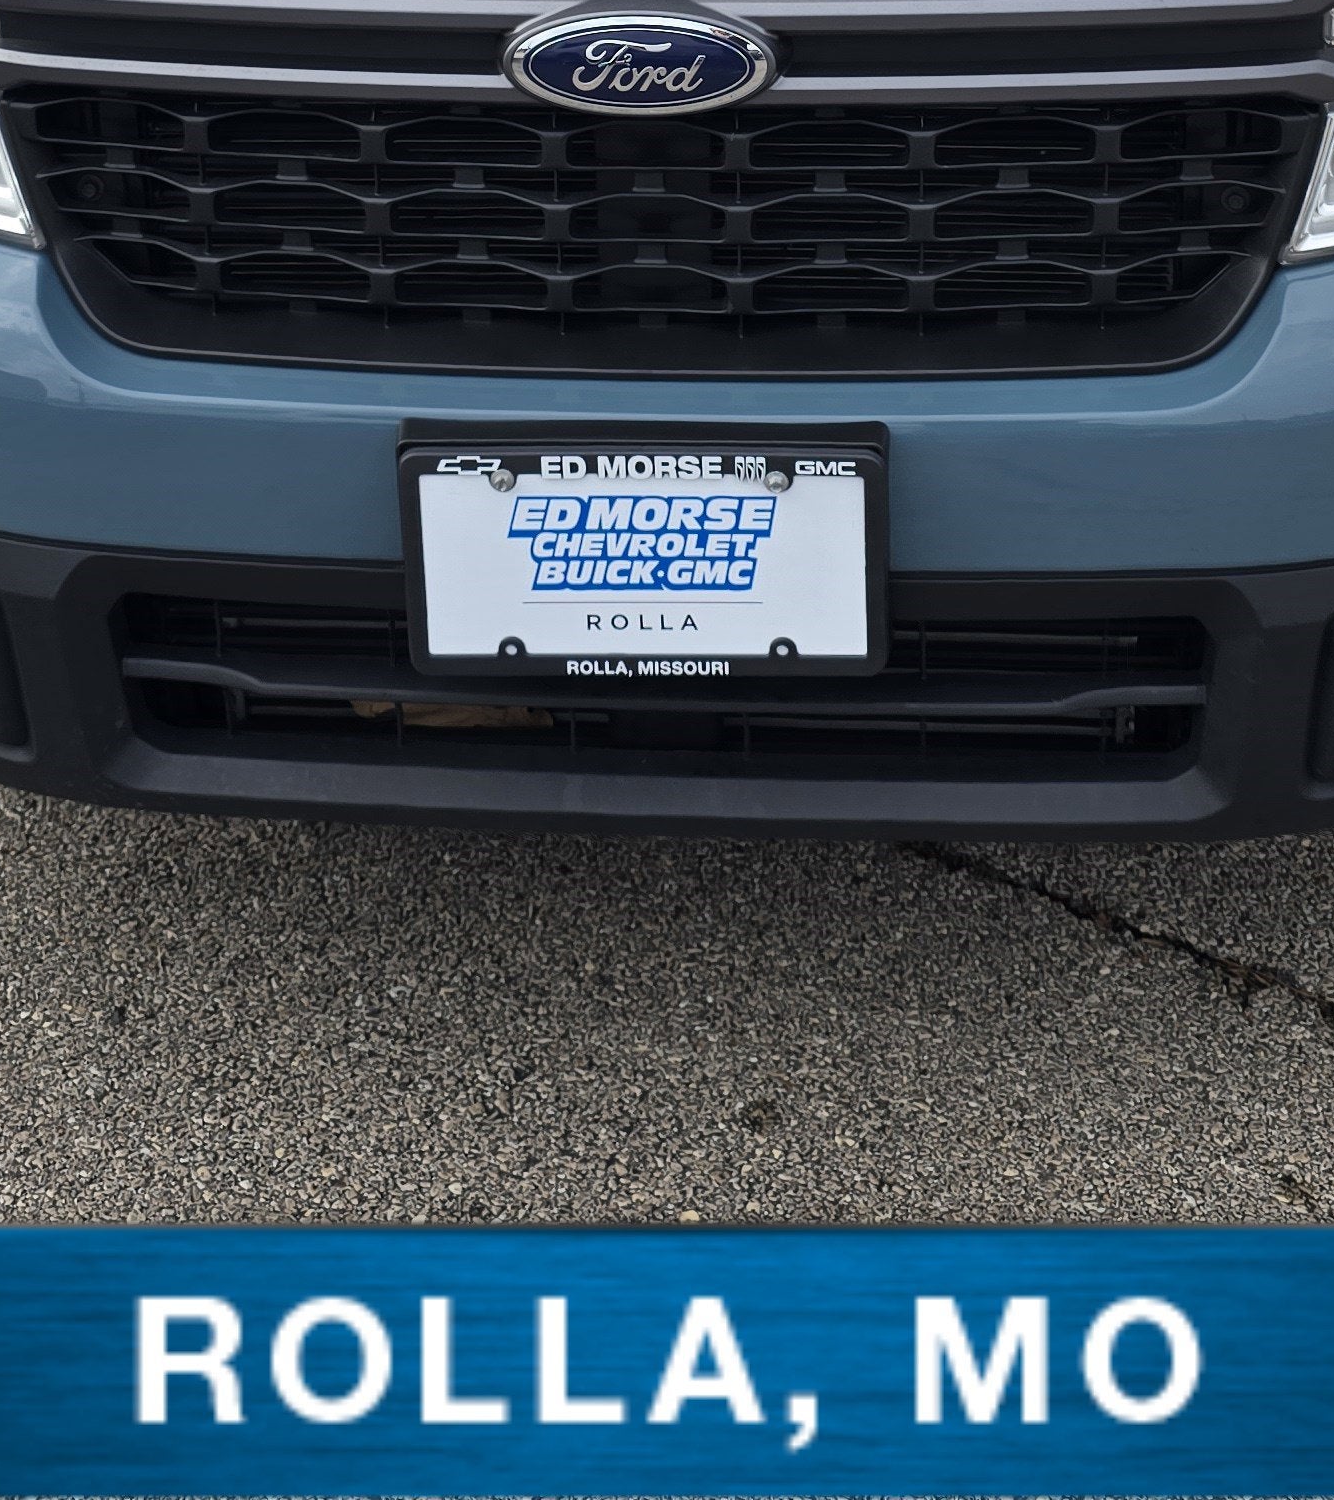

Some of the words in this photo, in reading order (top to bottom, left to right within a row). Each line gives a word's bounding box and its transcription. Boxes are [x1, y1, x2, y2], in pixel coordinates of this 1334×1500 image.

[572, 38, 707, 93] Ford
[540, 455, 587, 480] ED
[596, 455, 723, 480] MORSE
[794, 460, 857, 477] GMC
[511, 498, 582, 531] ED
[585, 498, 774, 531] MORSE
[532, 532, 755, 558] CHEVROLET
[586, 613, 699, 631] ROLLA
[566, 660, 633, 677] ROLLA,
[637, 660, 730, 676] MISSOURI
